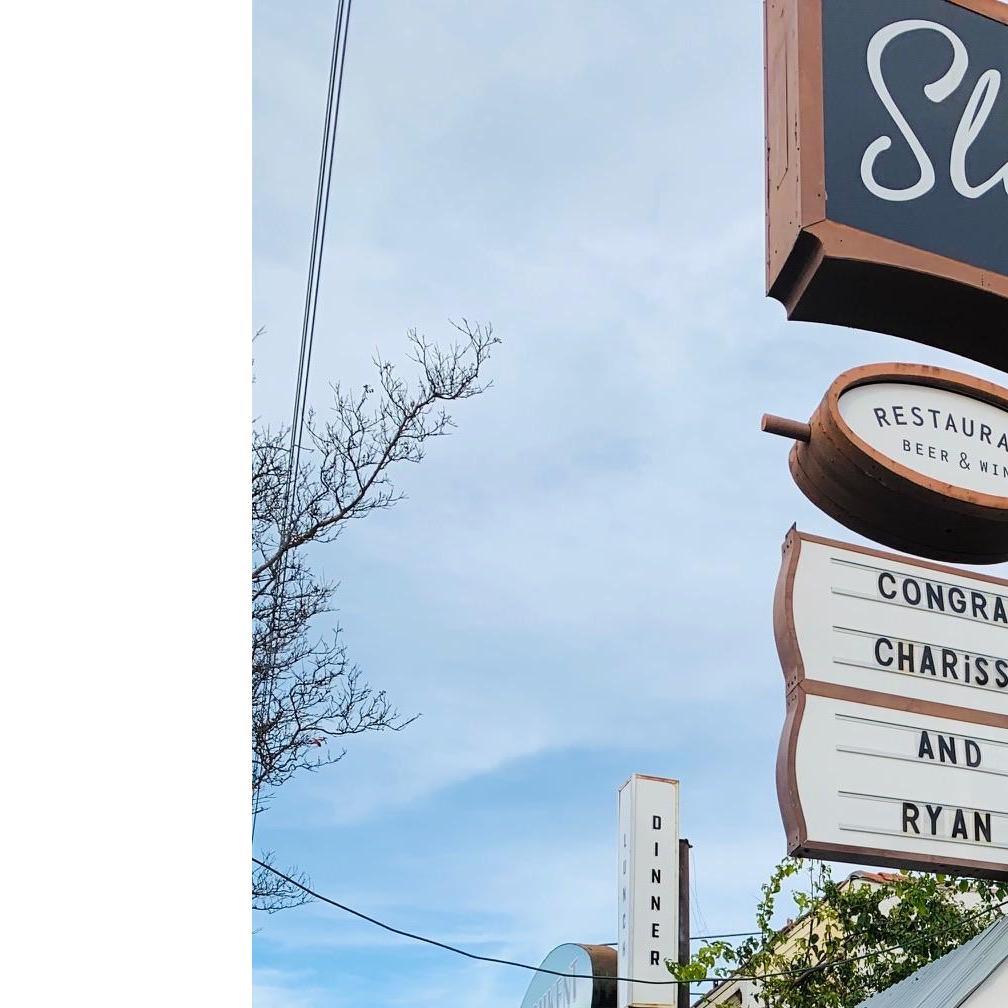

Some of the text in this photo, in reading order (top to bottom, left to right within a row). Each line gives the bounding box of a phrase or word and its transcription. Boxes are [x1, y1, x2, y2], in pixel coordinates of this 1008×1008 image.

[903, 439, 949, 464] BEER
[959, 452, 971, 470] &
[918, 730, 982, 769] AND
[902, 802, 992, 843] RYAN
[650, 815, 662, 966] DINNER
